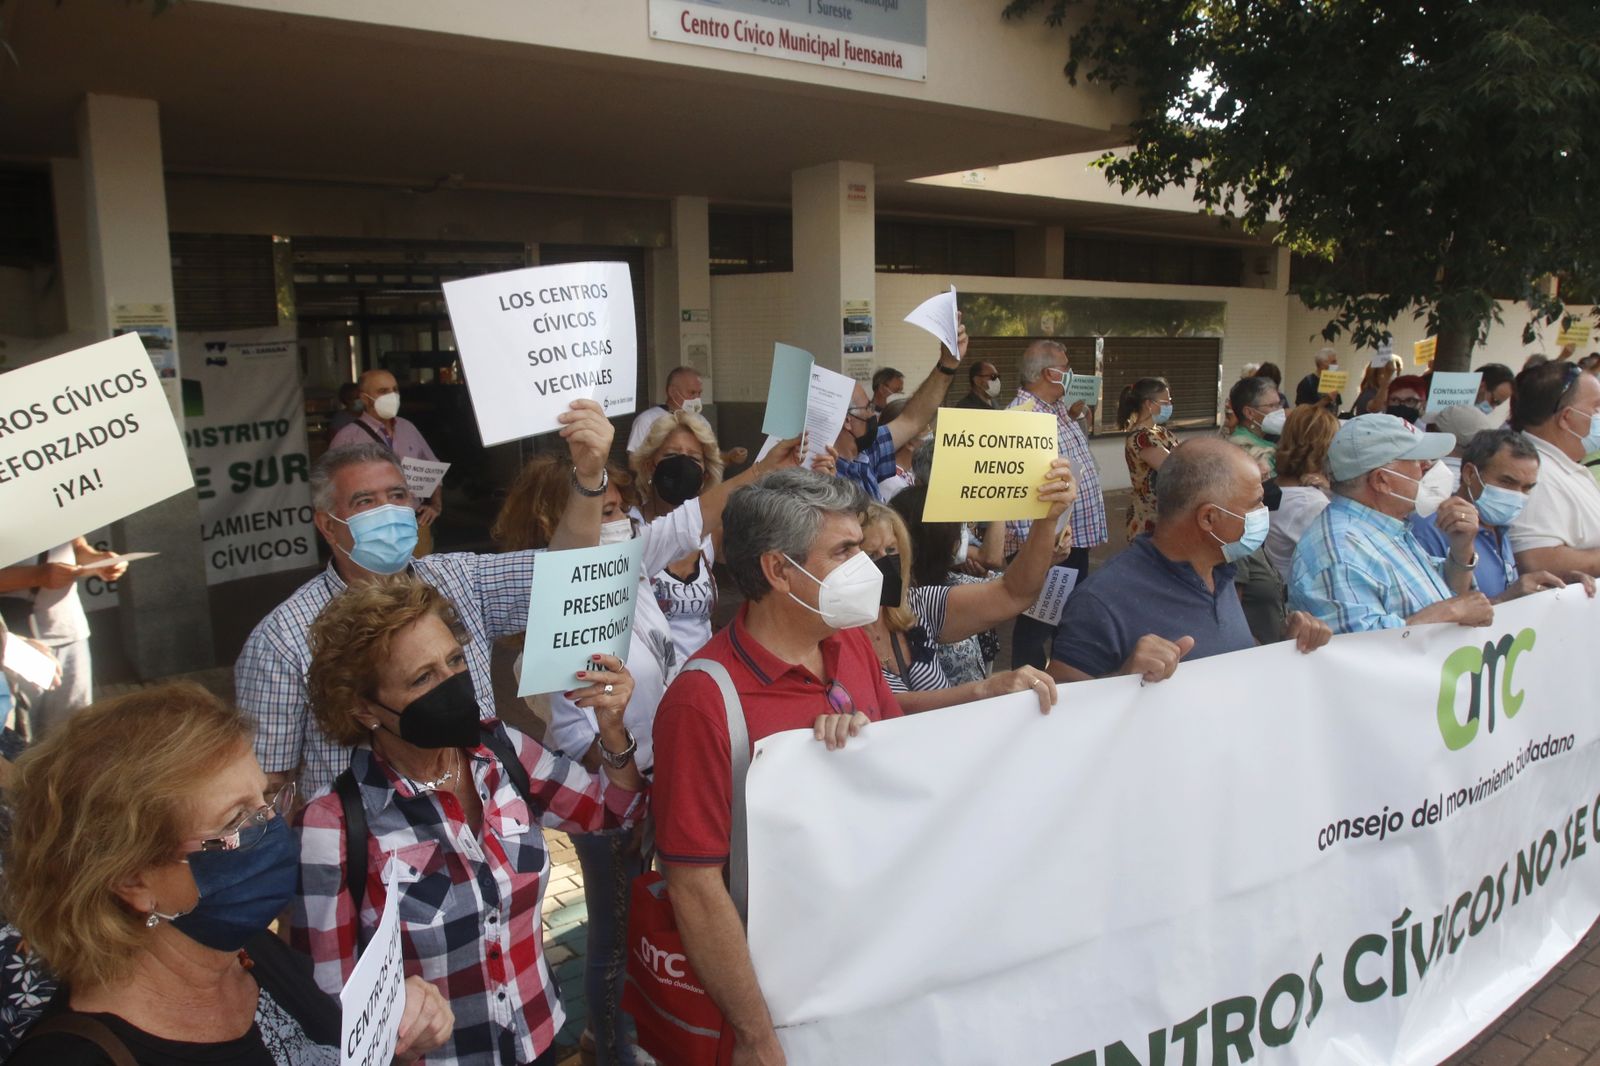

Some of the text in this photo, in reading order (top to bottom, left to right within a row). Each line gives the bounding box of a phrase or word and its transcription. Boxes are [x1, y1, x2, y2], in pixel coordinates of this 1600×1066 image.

[817, 0, 852, 20] Sureste
[681, 10, 903, 69] Centro Cívico Municipal Fuensanta
[499, 283, 608, 311] LOS CENTROS
[533, 311, 597, 334] CÍVICOS
[528, 339, 612, 366] SON CASAS
[52, 368, 147, 415] CÍVICOS
[534, 369, 612, 396] VECINALES
[942, 430, 1054, 450] MÁS CONTRATOS
[228, 453, 309, 494] SUR
[974, 460, 1025, 475] MENOS
[53, 468, 103, 508] ¡YA!
[960, 485, 1029, 499] RECORTES
[212, 537, 308, 570] CÍVICOS
[571, 554, 629, 583] ATENCIÓN
[1061, 573, 1070, 584] NO
[563, 587, 629, 616] PRESENCIAL
[1056, 584, 1066, 598] NOS
[553, 616, 629, 649] ELECTRÓNICA
[1318, 734, 1574, 851] consejo del movimiento ciudadano
[1343, 861, 1508, 1003] CÍVICOS
[1512, 829, 1557, 906] NO
[1561, 804, 1588, 870] SE
[347, 954, 389, 1059] CENTROS
